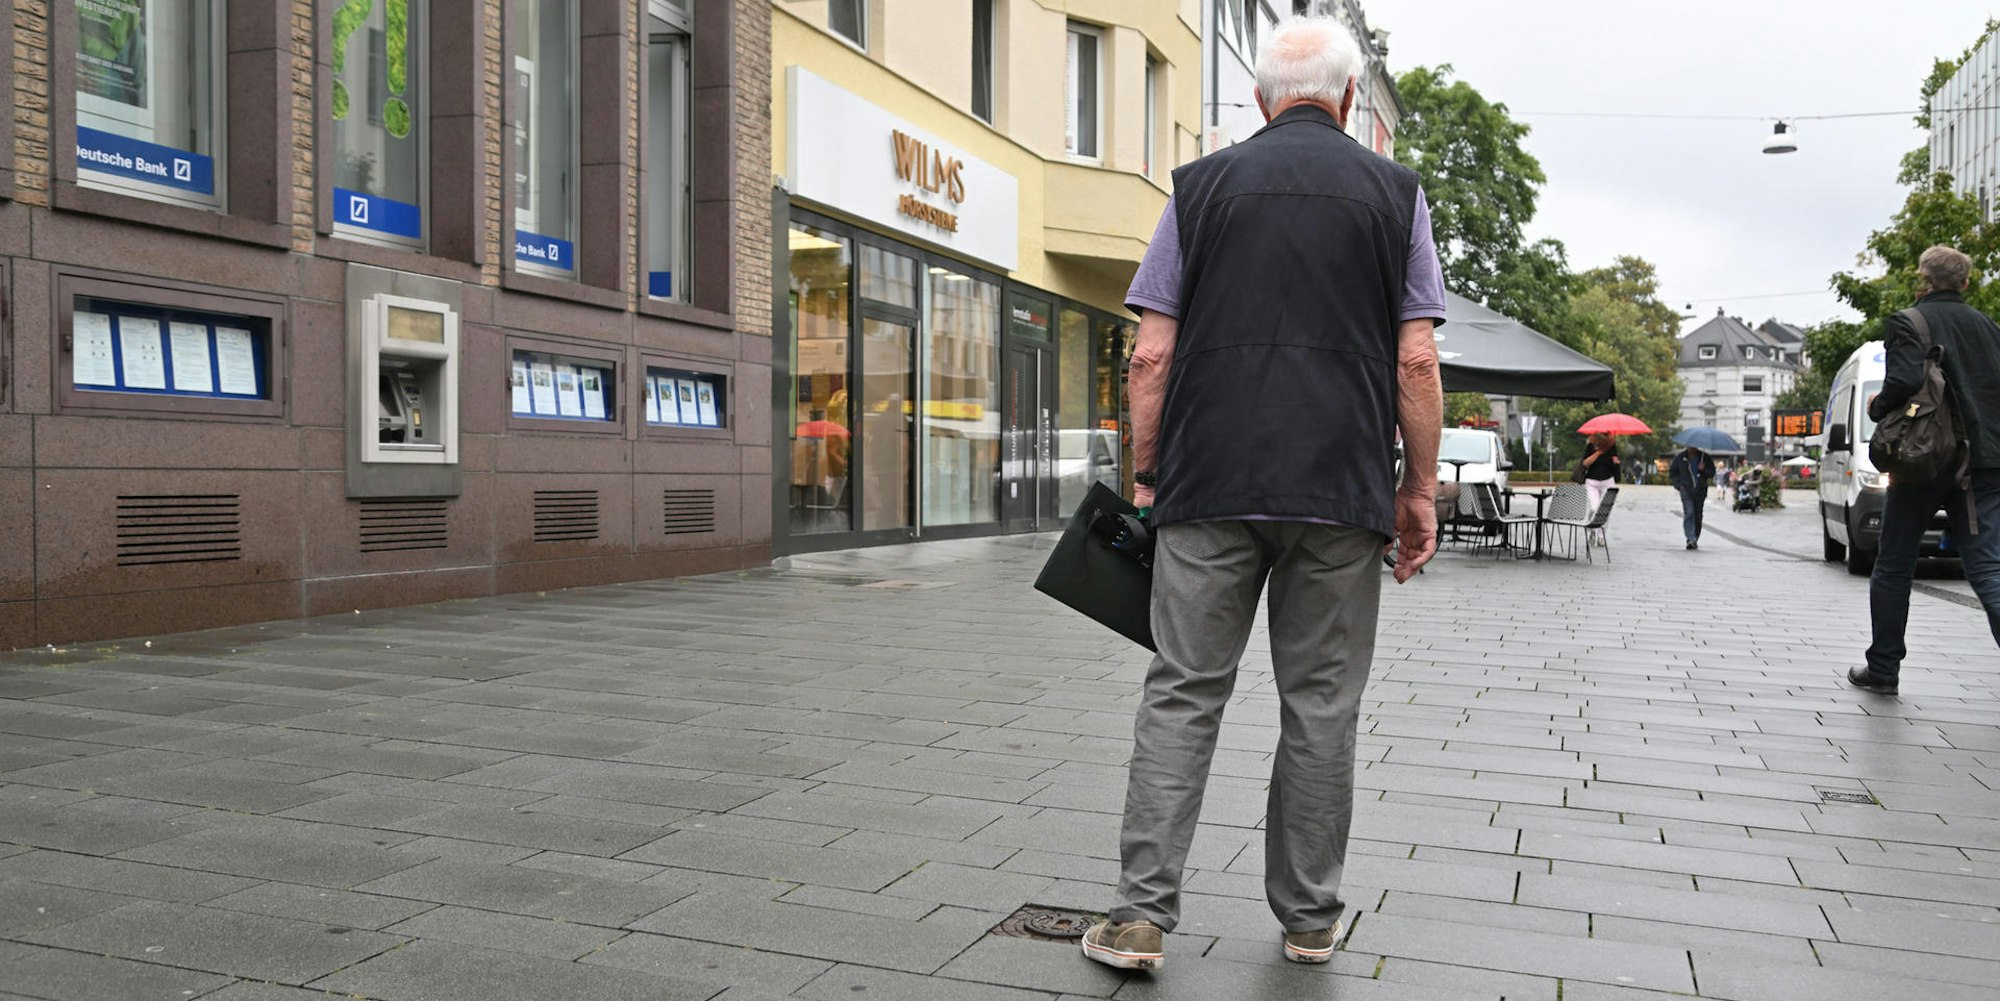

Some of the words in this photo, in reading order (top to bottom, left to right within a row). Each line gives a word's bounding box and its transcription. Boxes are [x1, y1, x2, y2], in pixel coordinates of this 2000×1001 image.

[135, 156, 168, 177] Bank
[892, 129, 965, 203] WILMS
[527, 245, 546, 258] Bank
